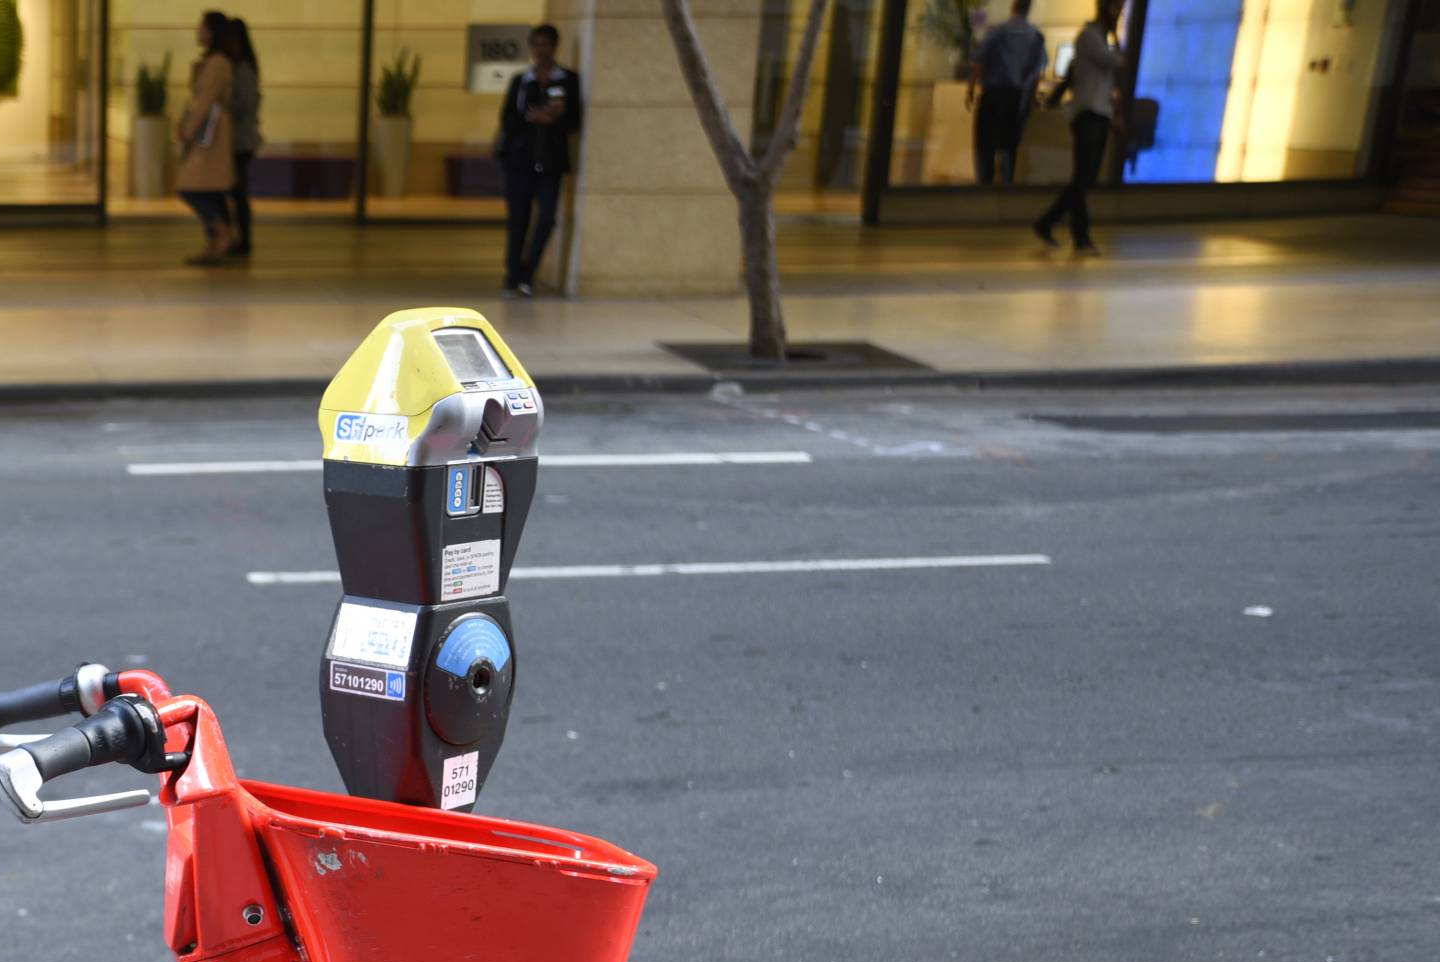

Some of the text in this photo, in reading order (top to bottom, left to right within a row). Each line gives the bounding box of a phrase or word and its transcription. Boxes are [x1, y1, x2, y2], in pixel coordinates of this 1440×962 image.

[334, 673, 384, 692] 57101290
[451, 765, 469, 780] 571
[444, 779, 474, 797] 01290
